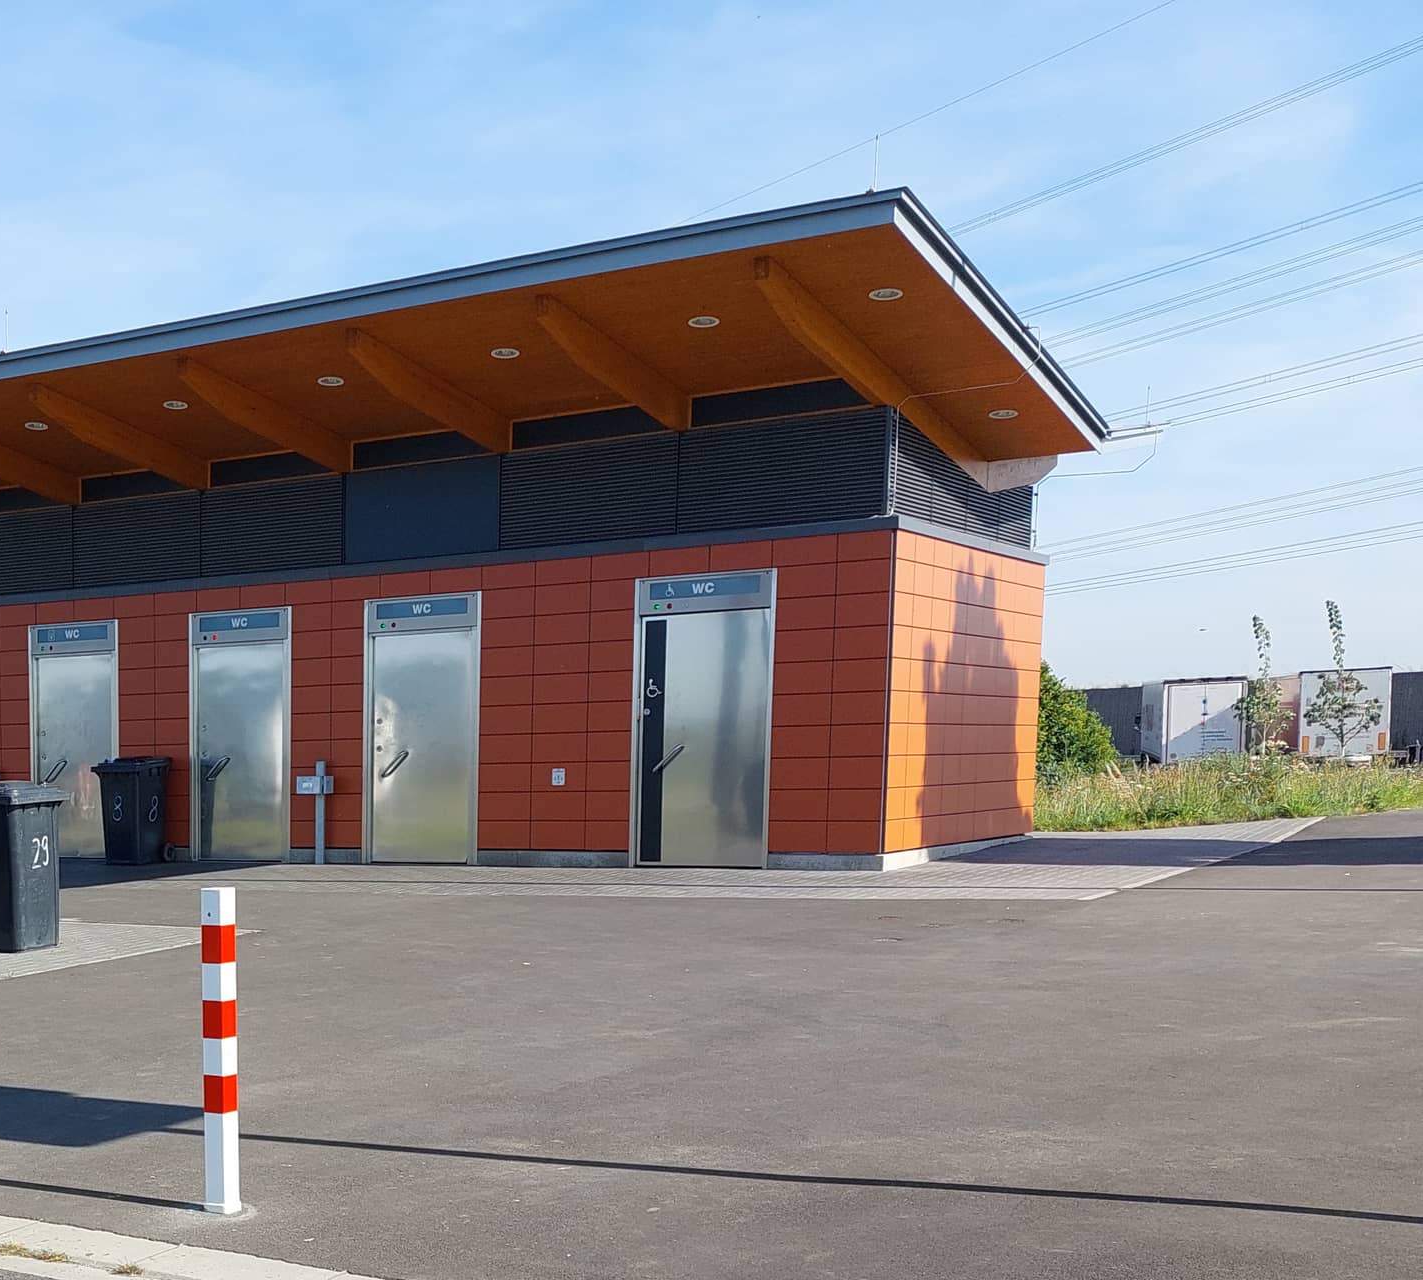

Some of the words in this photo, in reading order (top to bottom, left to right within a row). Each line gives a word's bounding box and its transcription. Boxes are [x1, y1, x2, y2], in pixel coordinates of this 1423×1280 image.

[692, 582, 715, 595] WC
[412, 603, 432, 615] WC
[231, 617, 248, 628] WC
[64, 628, 80, 639] WC
[112, 795, 123, 822] 8
[148, 795, 159, 823] 8
[31, 835, 50, 870] 29
